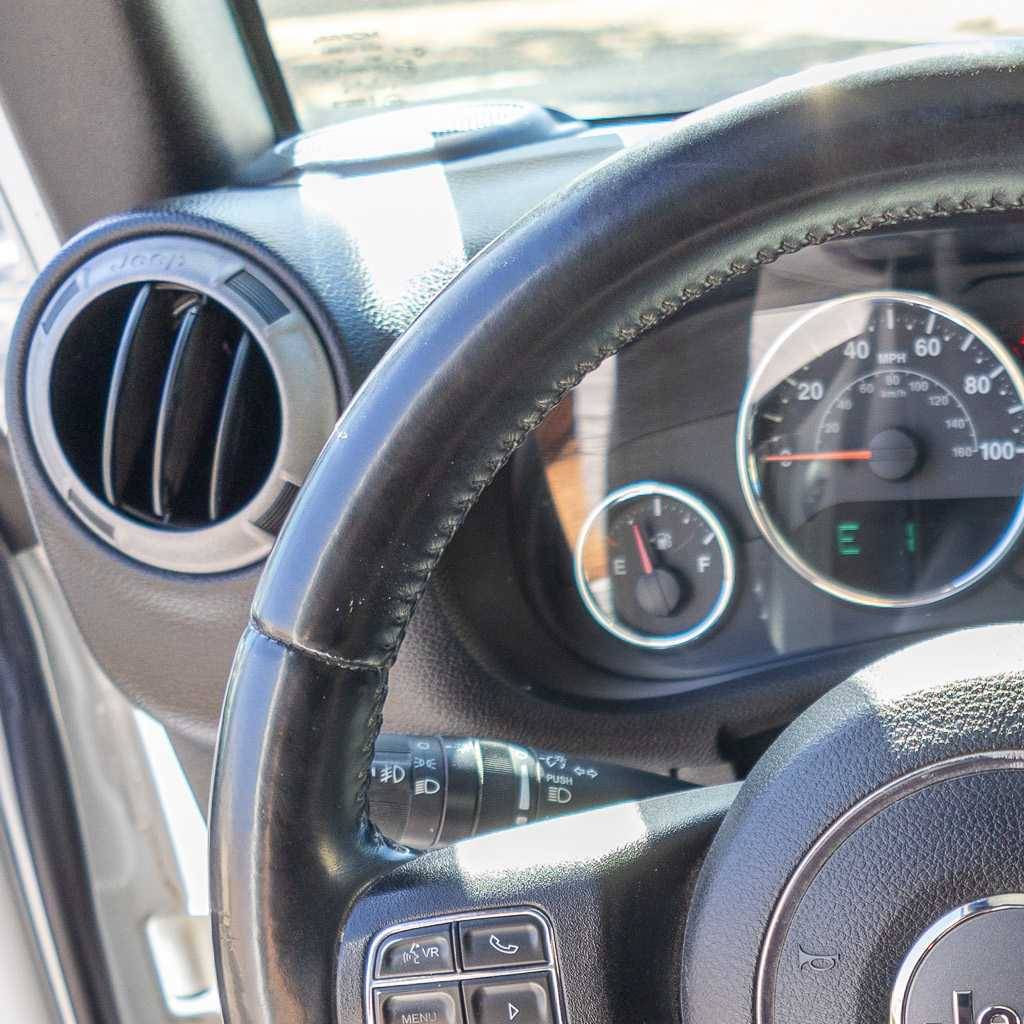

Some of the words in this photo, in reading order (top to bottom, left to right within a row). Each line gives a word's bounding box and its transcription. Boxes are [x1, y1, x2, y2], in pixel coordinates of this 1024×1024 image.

[843, 341, 869, 360] 40
[914, 338, 941, 357] 60
[878, 353, 906, 364] MPH
[798, 382, 824, 400] 20
[909, 381, 929, 392] 100
[964, 376, 991, 394] 80
[929, 396, 949, 406] 120
[945, 419, 966, 429] 140
[980, 443, 1014, 460] 100
[838, 523, 860, 556] E
[614, 559, 626, 576] E
[697, 556, 711, 573] F
[546, 774, 573, 786] PUSH
[423, 946, 439, 959] VR
[401, 1012, 438, 1024] MENU
